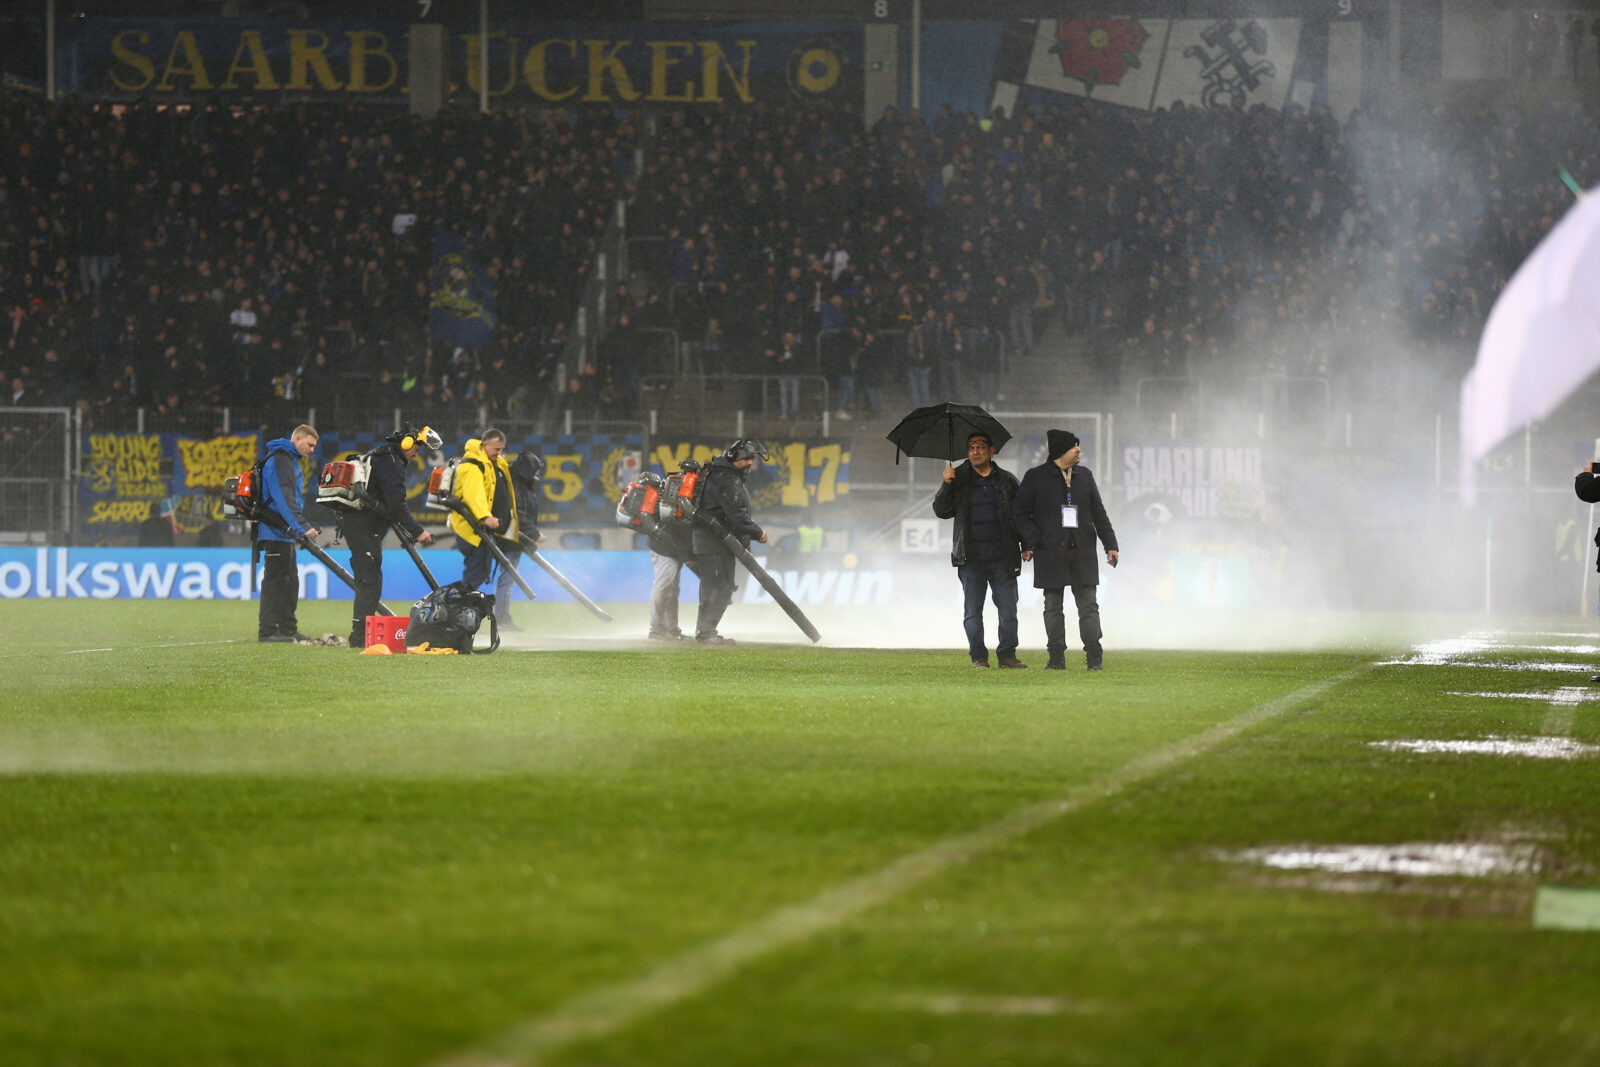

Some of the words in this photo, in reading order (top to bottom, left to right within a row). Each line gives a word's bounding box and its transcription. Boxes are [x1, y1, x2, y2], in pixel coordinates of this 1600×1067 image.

[418, 0, 432, 19] 7
[874, 0, 889, 18] 8
[1338, 0, 1352, 16] 9
[89, 433, 162, 459] YOUNG
[1123, 446, 1262, 486] SAARLAND
[905, 527, 934, 548] E4
[0, 546, 329, 600] olkswagn
